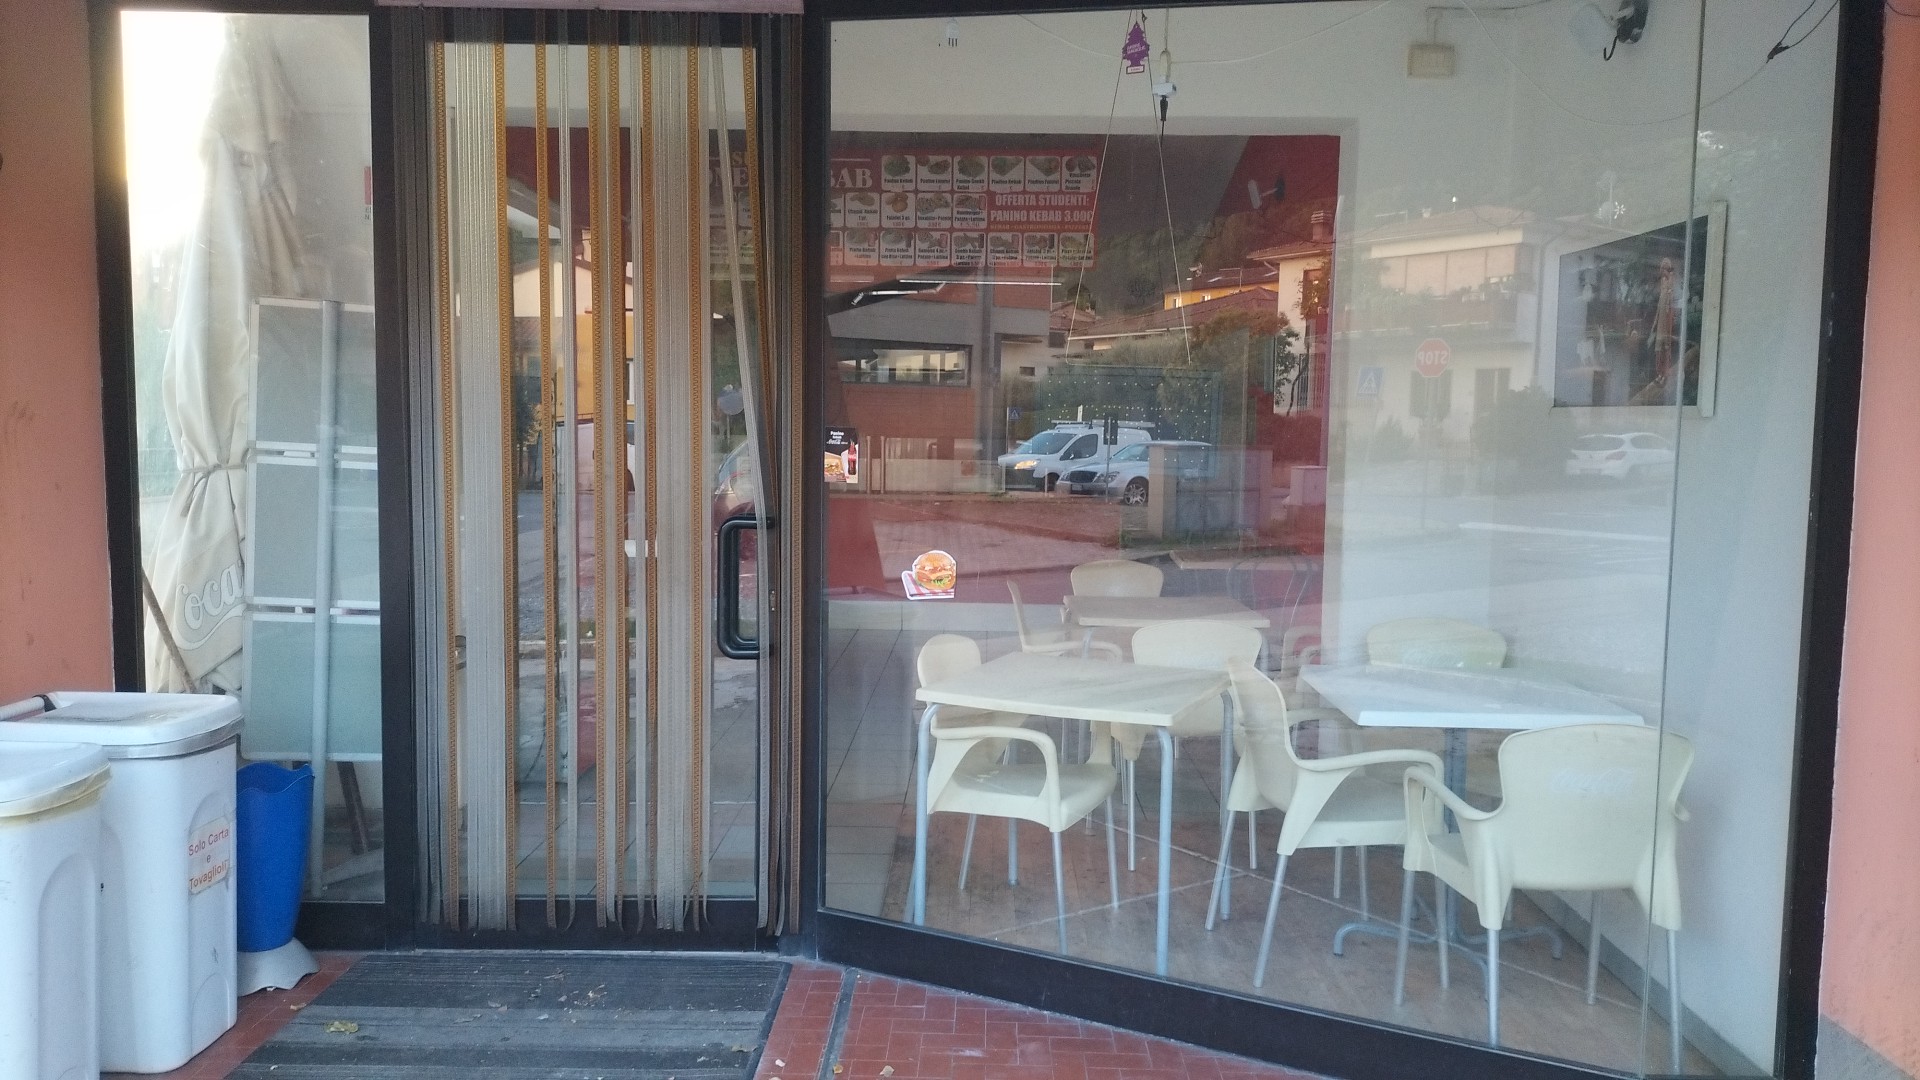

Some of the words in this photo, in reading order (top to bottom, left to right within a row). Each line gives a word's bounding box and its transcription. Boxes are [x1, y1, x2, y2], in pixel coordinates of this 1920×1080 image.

[996, 195, 1037, 206] OFFERTA
[990, 210, 1028, 221] PANINO
[1029, 210, 1062, 221] KEBAB
[188, 840, 206, 856] Solo
[208, 828, 229, 846] Carta
[206, 854, 212, 863] e
[189, 862, 228, 890] Tovaglioli
